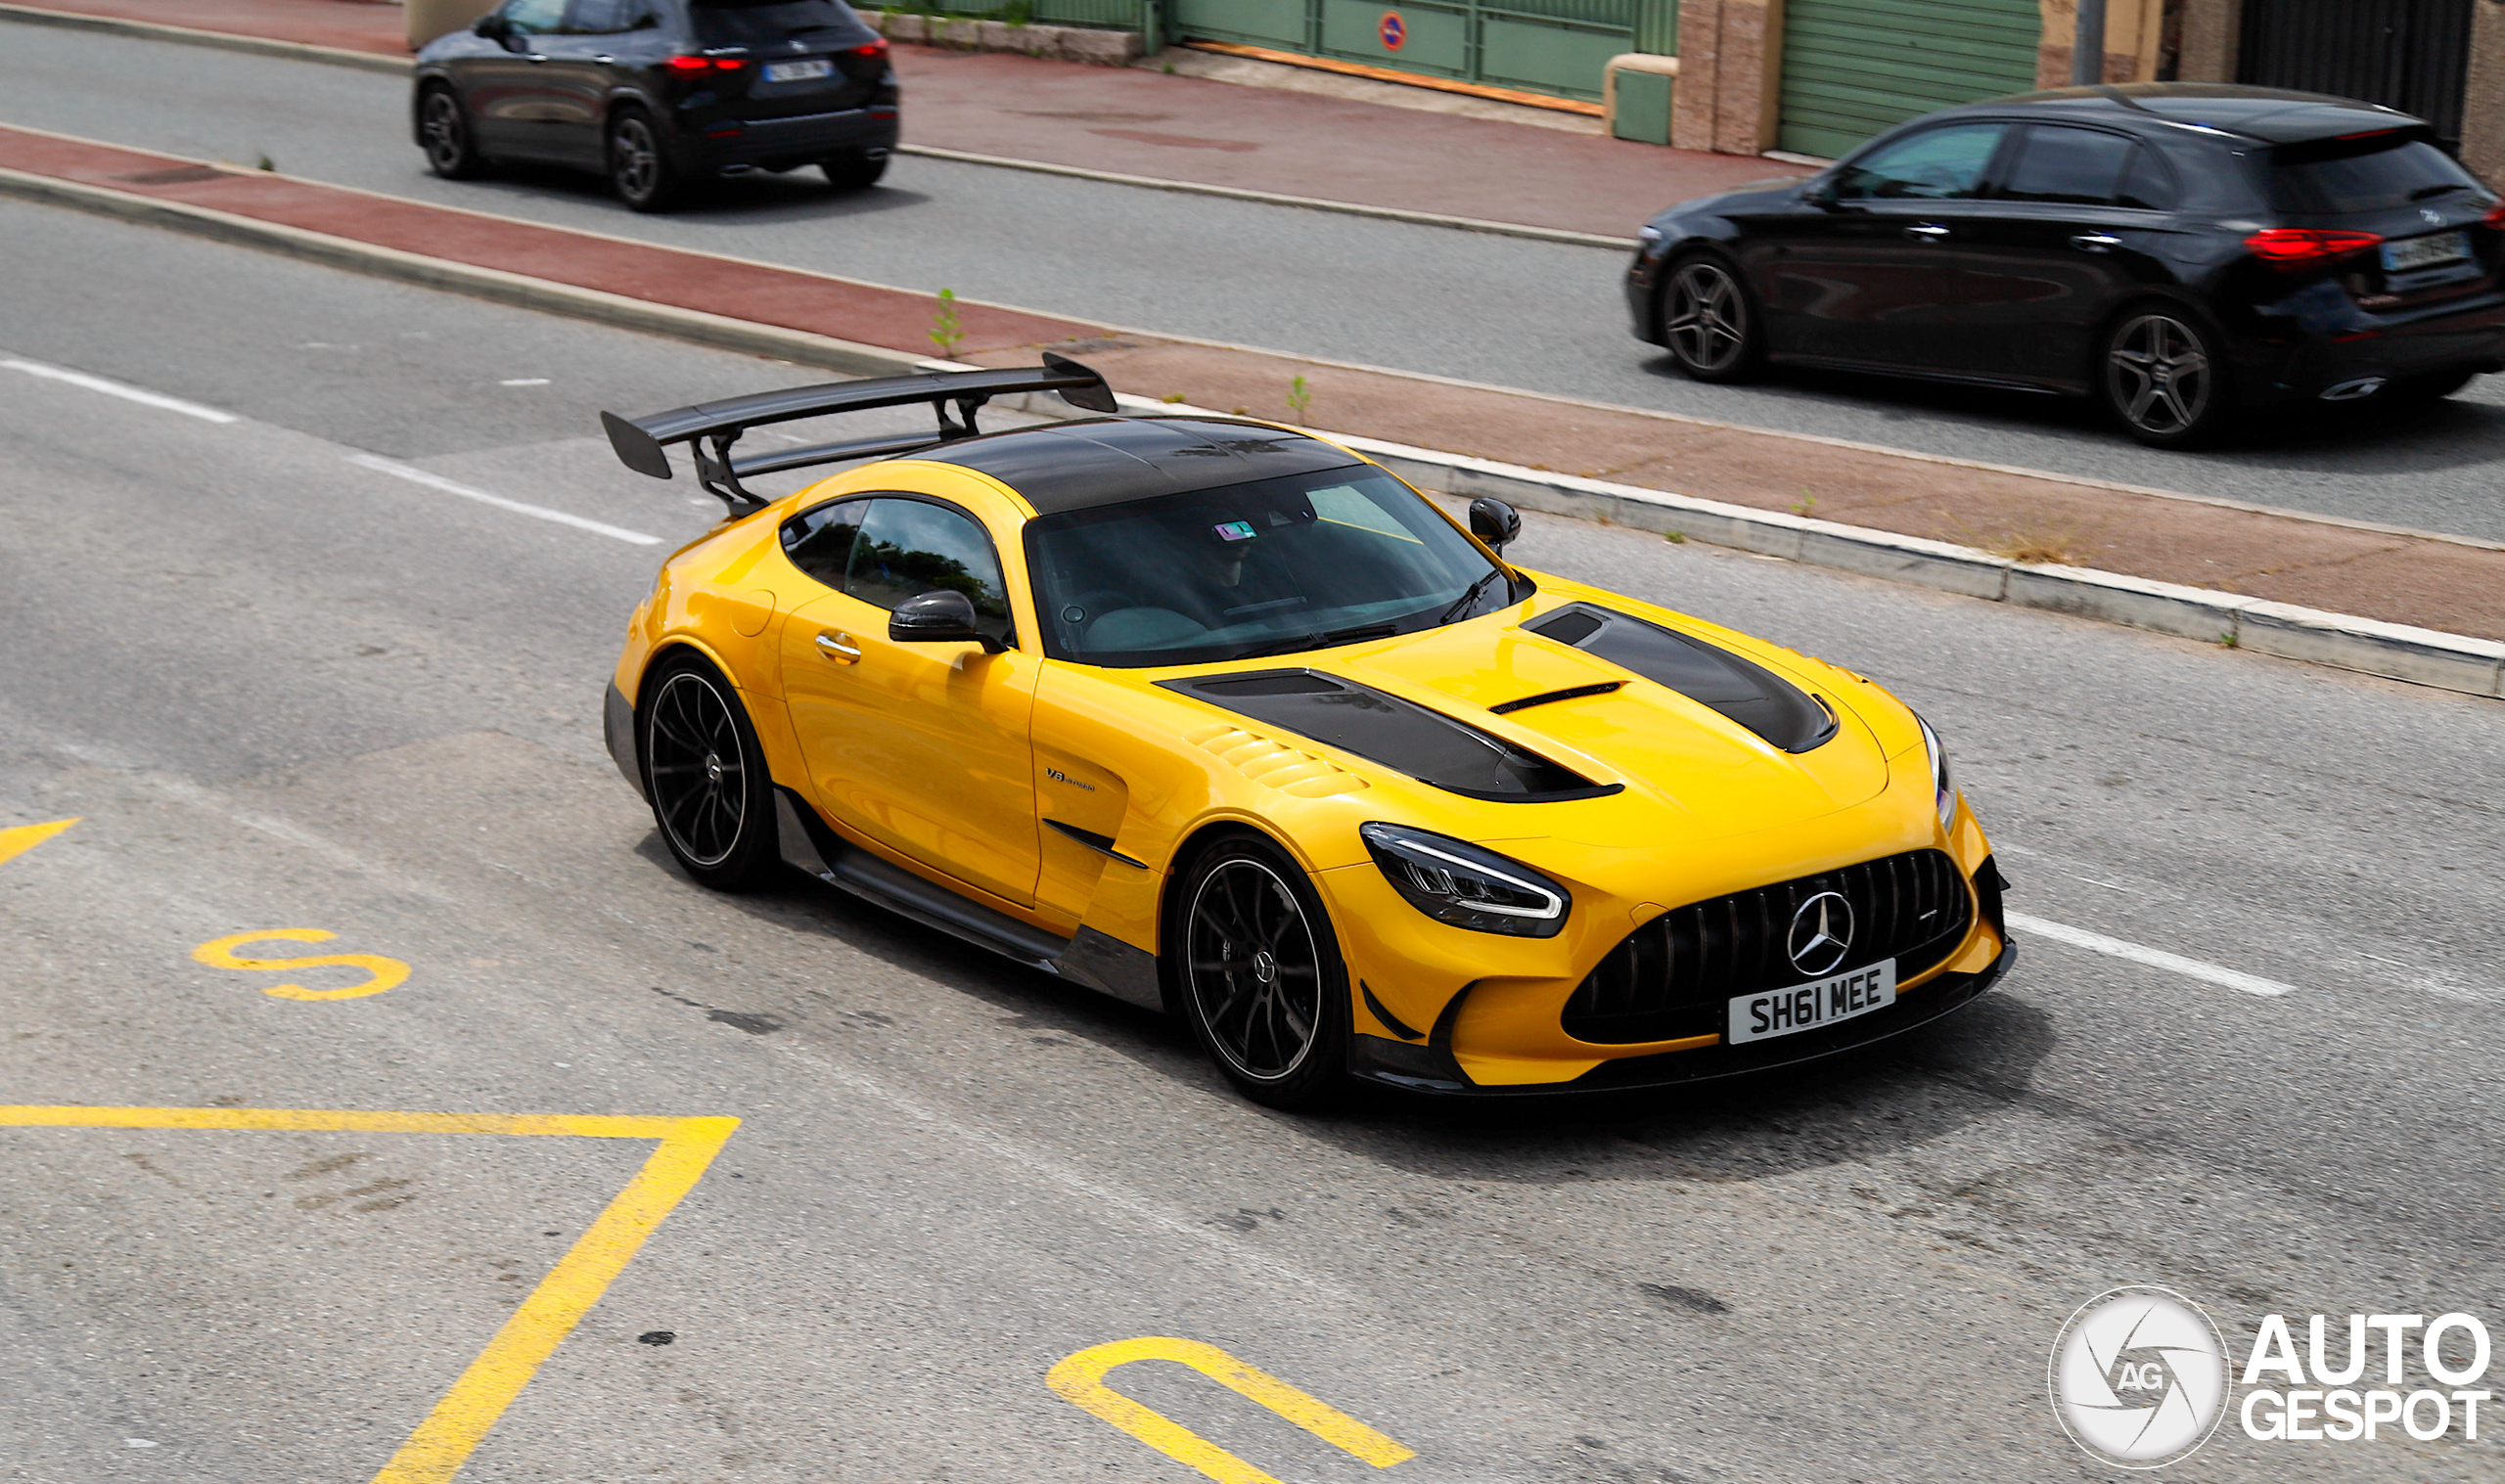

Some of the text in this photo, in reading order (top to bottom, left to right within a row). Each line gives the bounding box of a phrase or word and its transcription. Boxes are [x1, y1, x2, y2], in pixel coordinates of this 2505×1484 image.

[1046, 768, 1065, 782] V8
[191, 926, 412, 1002] S
[1750, 968, 1881, 1034] SH61 MEE
